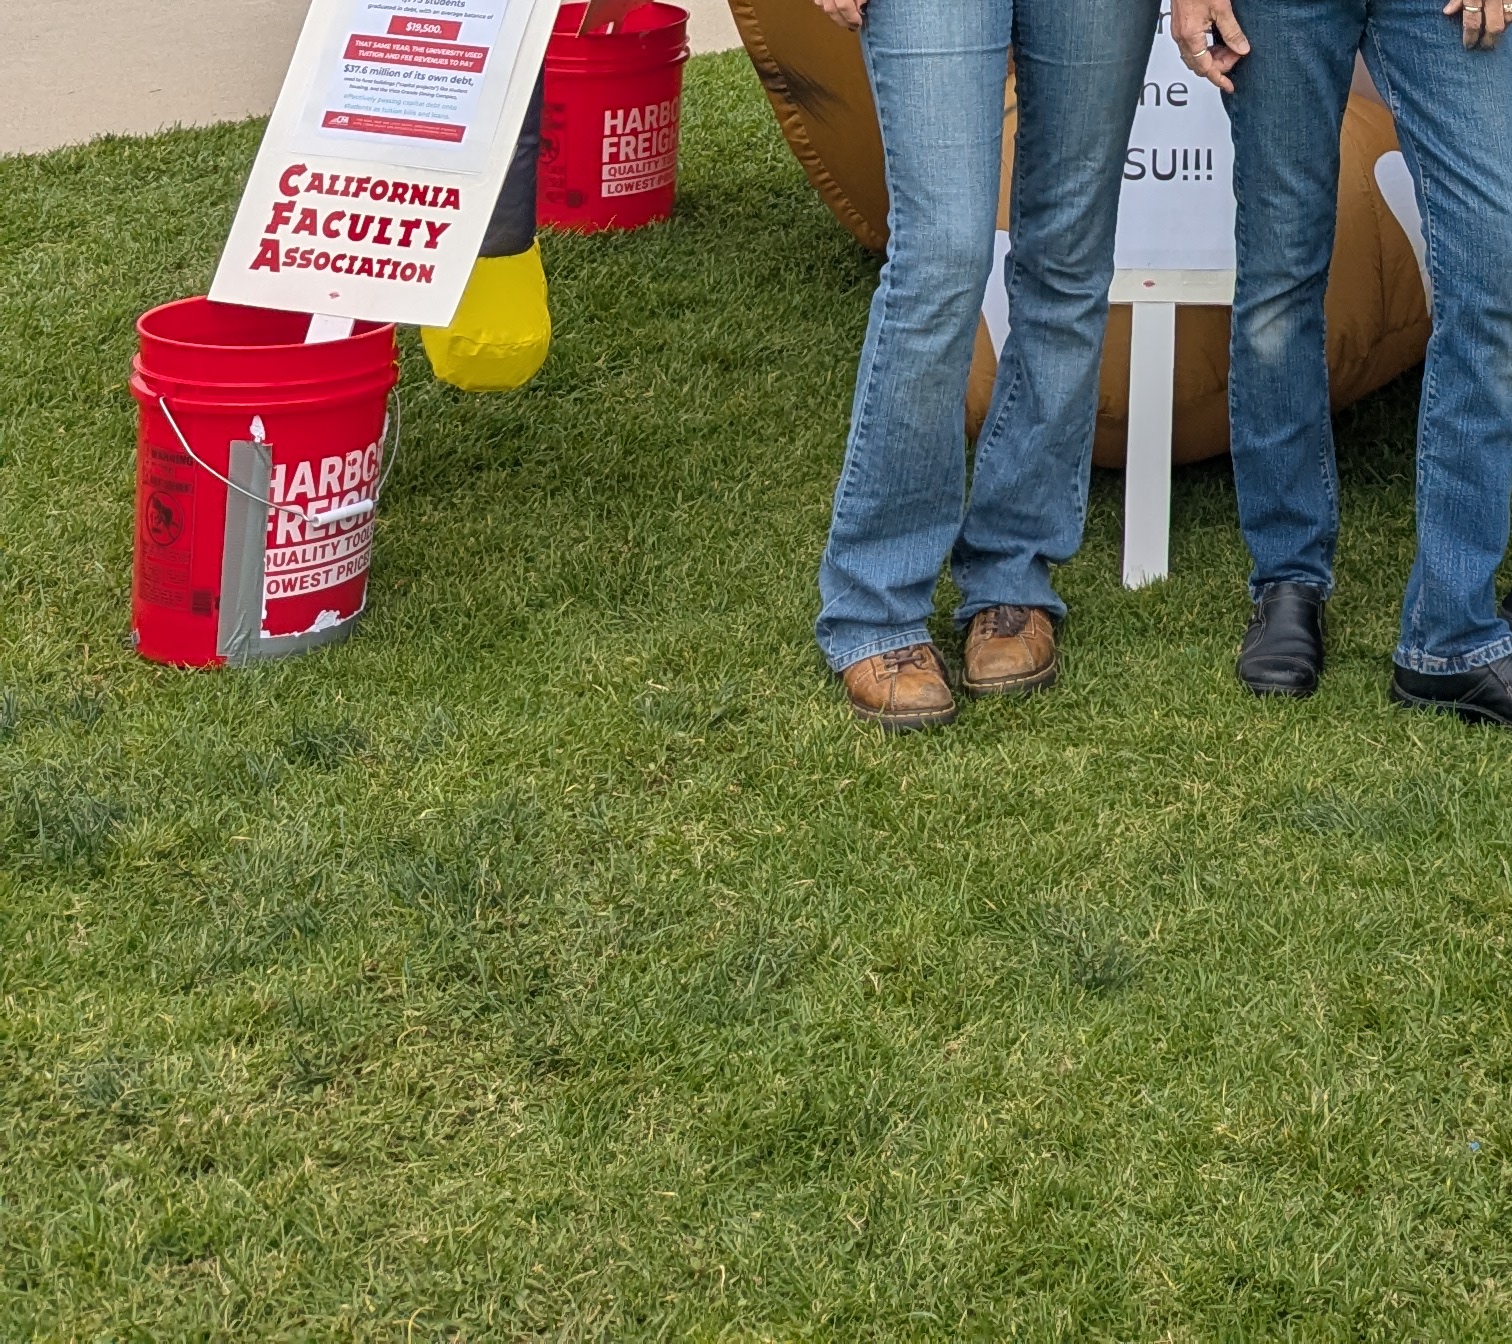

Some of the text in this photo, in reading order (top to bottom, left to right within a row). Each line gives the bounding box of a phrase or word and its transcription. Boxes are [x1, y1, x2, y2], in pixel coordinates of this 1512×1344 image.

[344, 64, 474, 86] $37.6 million of its own debt,
[604, 96, 679, 136] HARBO
[602, 125, 678, 163] FREIGH
[608, 159, 659, 178] QUALITY
[1123, 148, 1213, 181] SU!!!
[279, 163, 460, 210] CALIFORNIA
[607, 178, 655, 194] LOWEST
[264, 200, 452, 249] FACULTY
[249, 238, 435, 284] ASSOCIATION
[269, 438, 383, 503] HARBO
[266, 486, 377, 545] FREIGH
[267, 540, 341, 570] UALITY
[266, 569, 333, 595] OWEST
